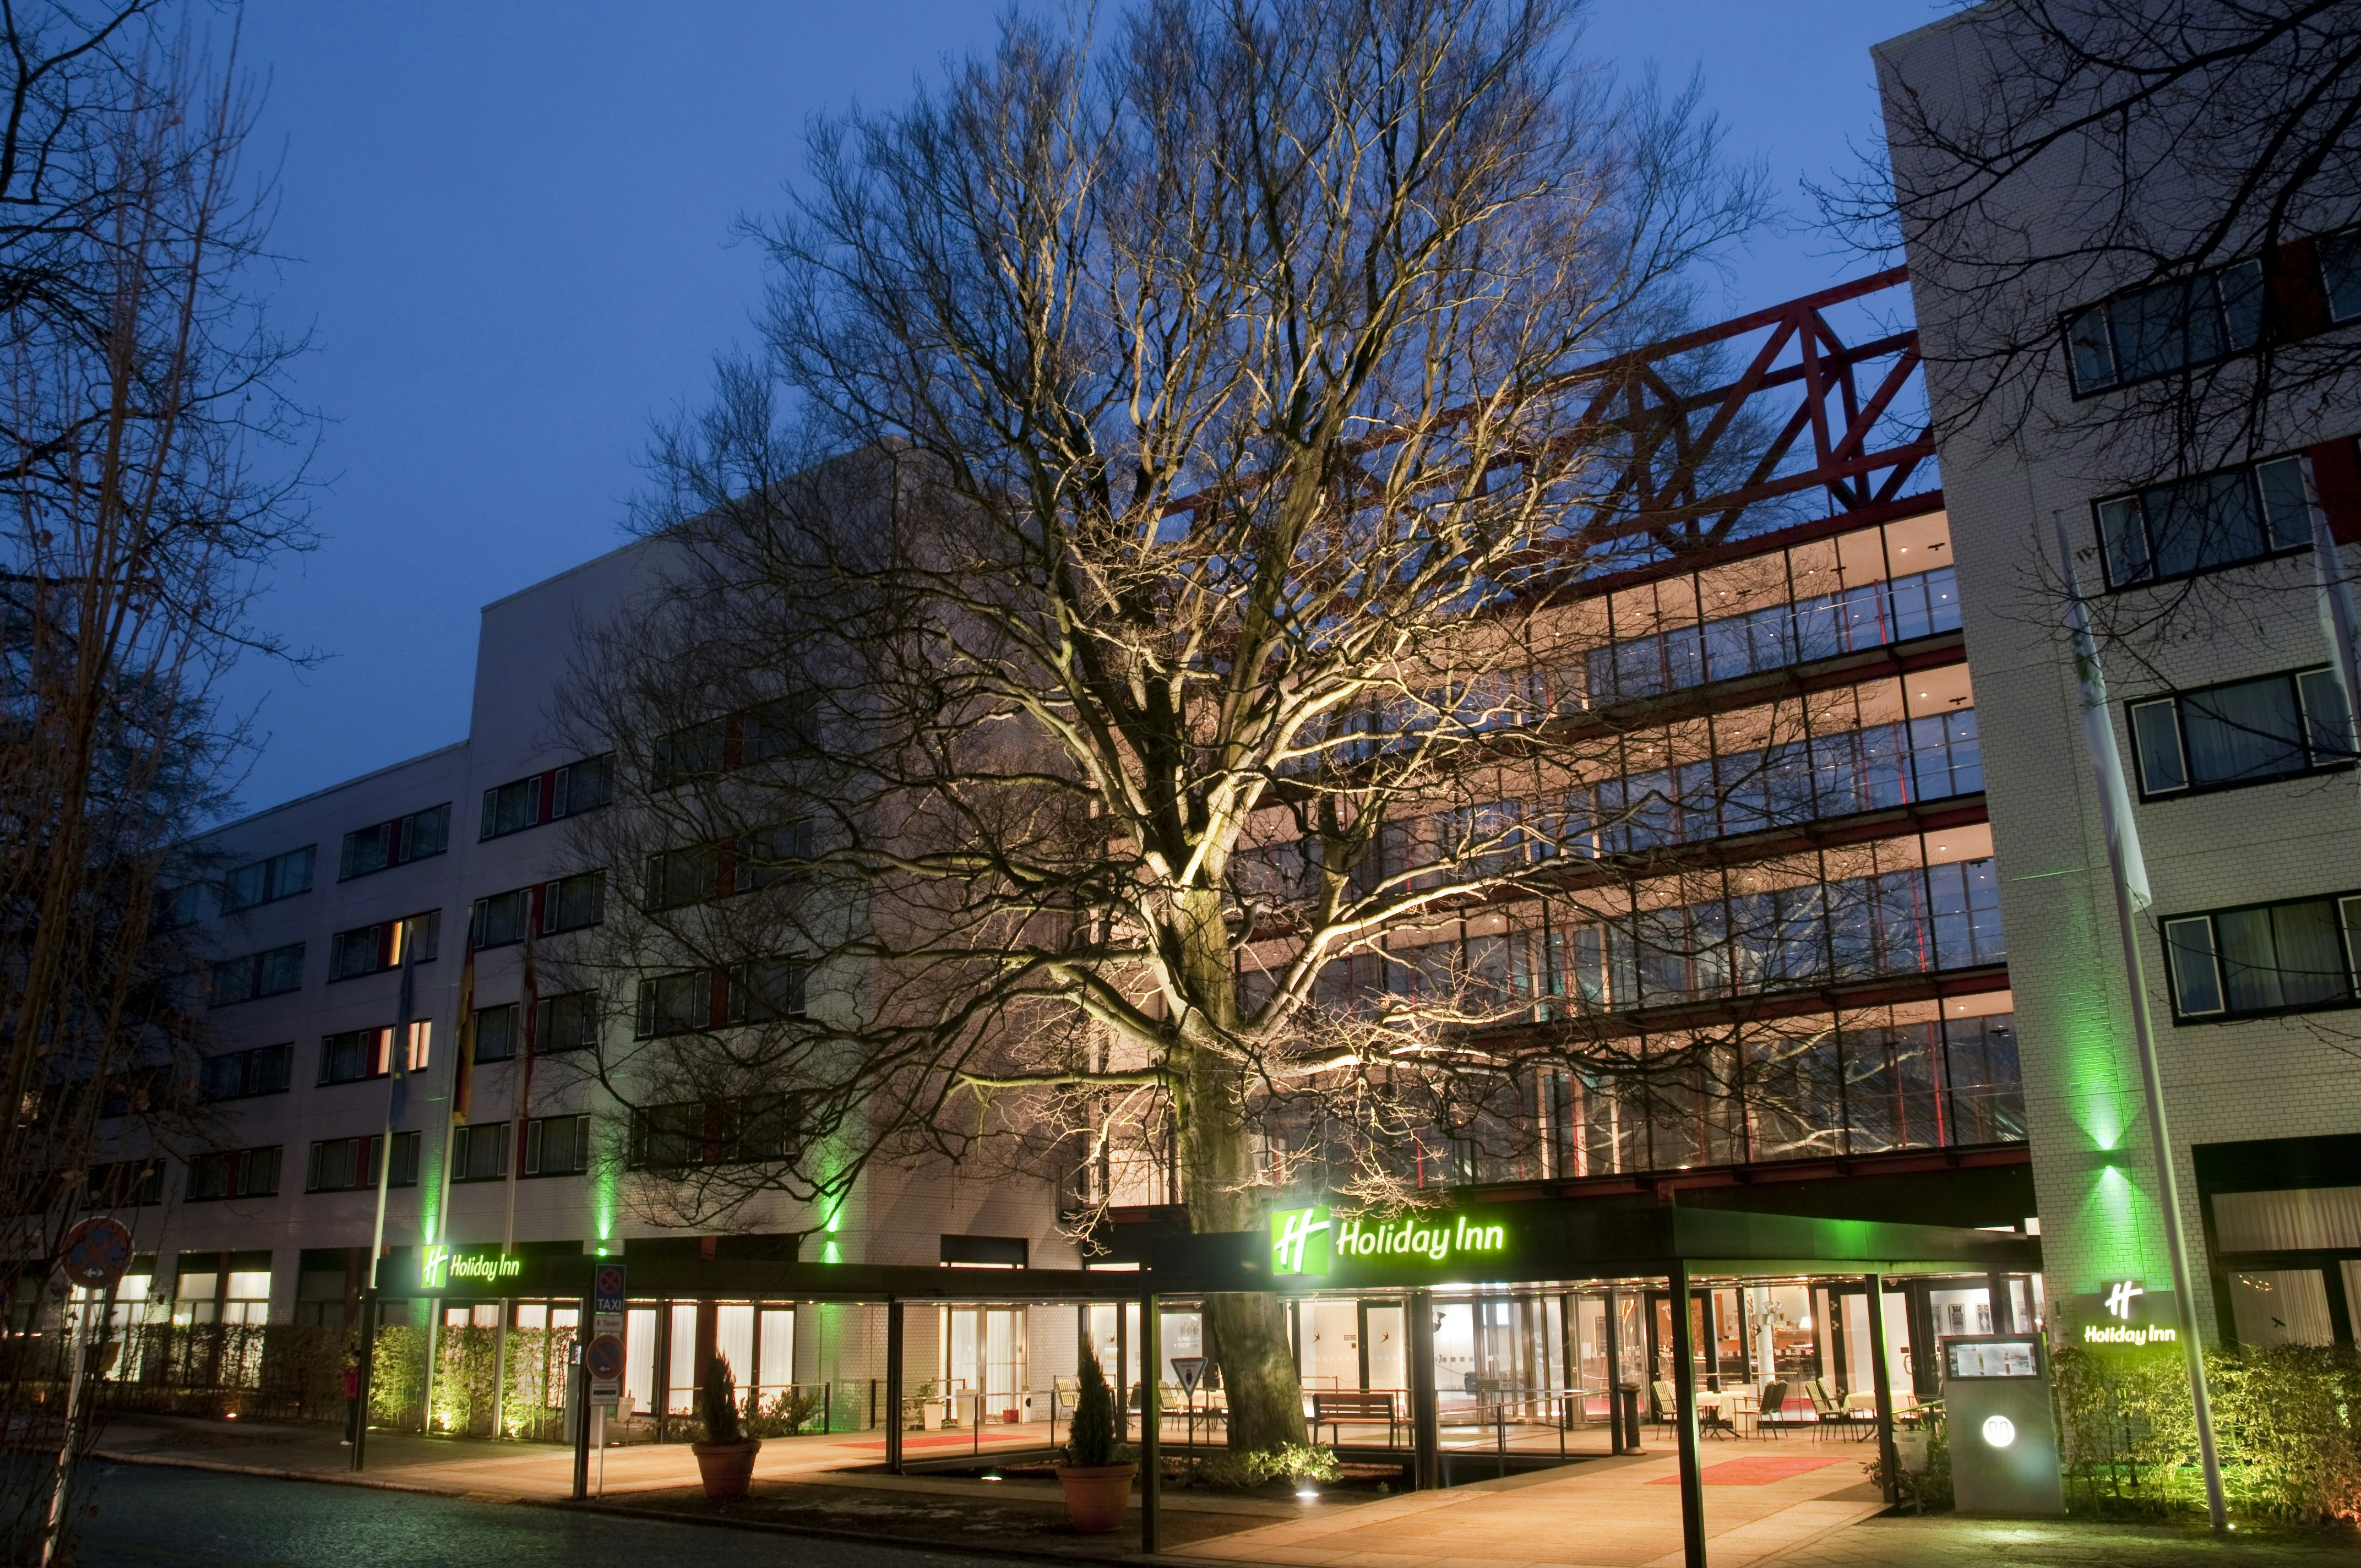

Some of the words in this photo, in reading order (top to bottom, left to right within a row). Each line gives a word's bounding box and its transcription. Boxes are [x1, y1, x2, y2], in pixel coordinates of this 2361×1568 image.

[1336, 1220, 1451, 1260] Holiday
[1456, 1216, 1504, 1250] Inn
[450, 1254, 498, 1282] Holiday
[499, 1253, 520, 1276] Inn
[597, 1299, 622, 1310] TAXI
[2084, 1325, 2147, 1346] Holiday
[2148, 1324, 2177, 1342] Inn
[1988, 1421, 2009, 1441] 80
